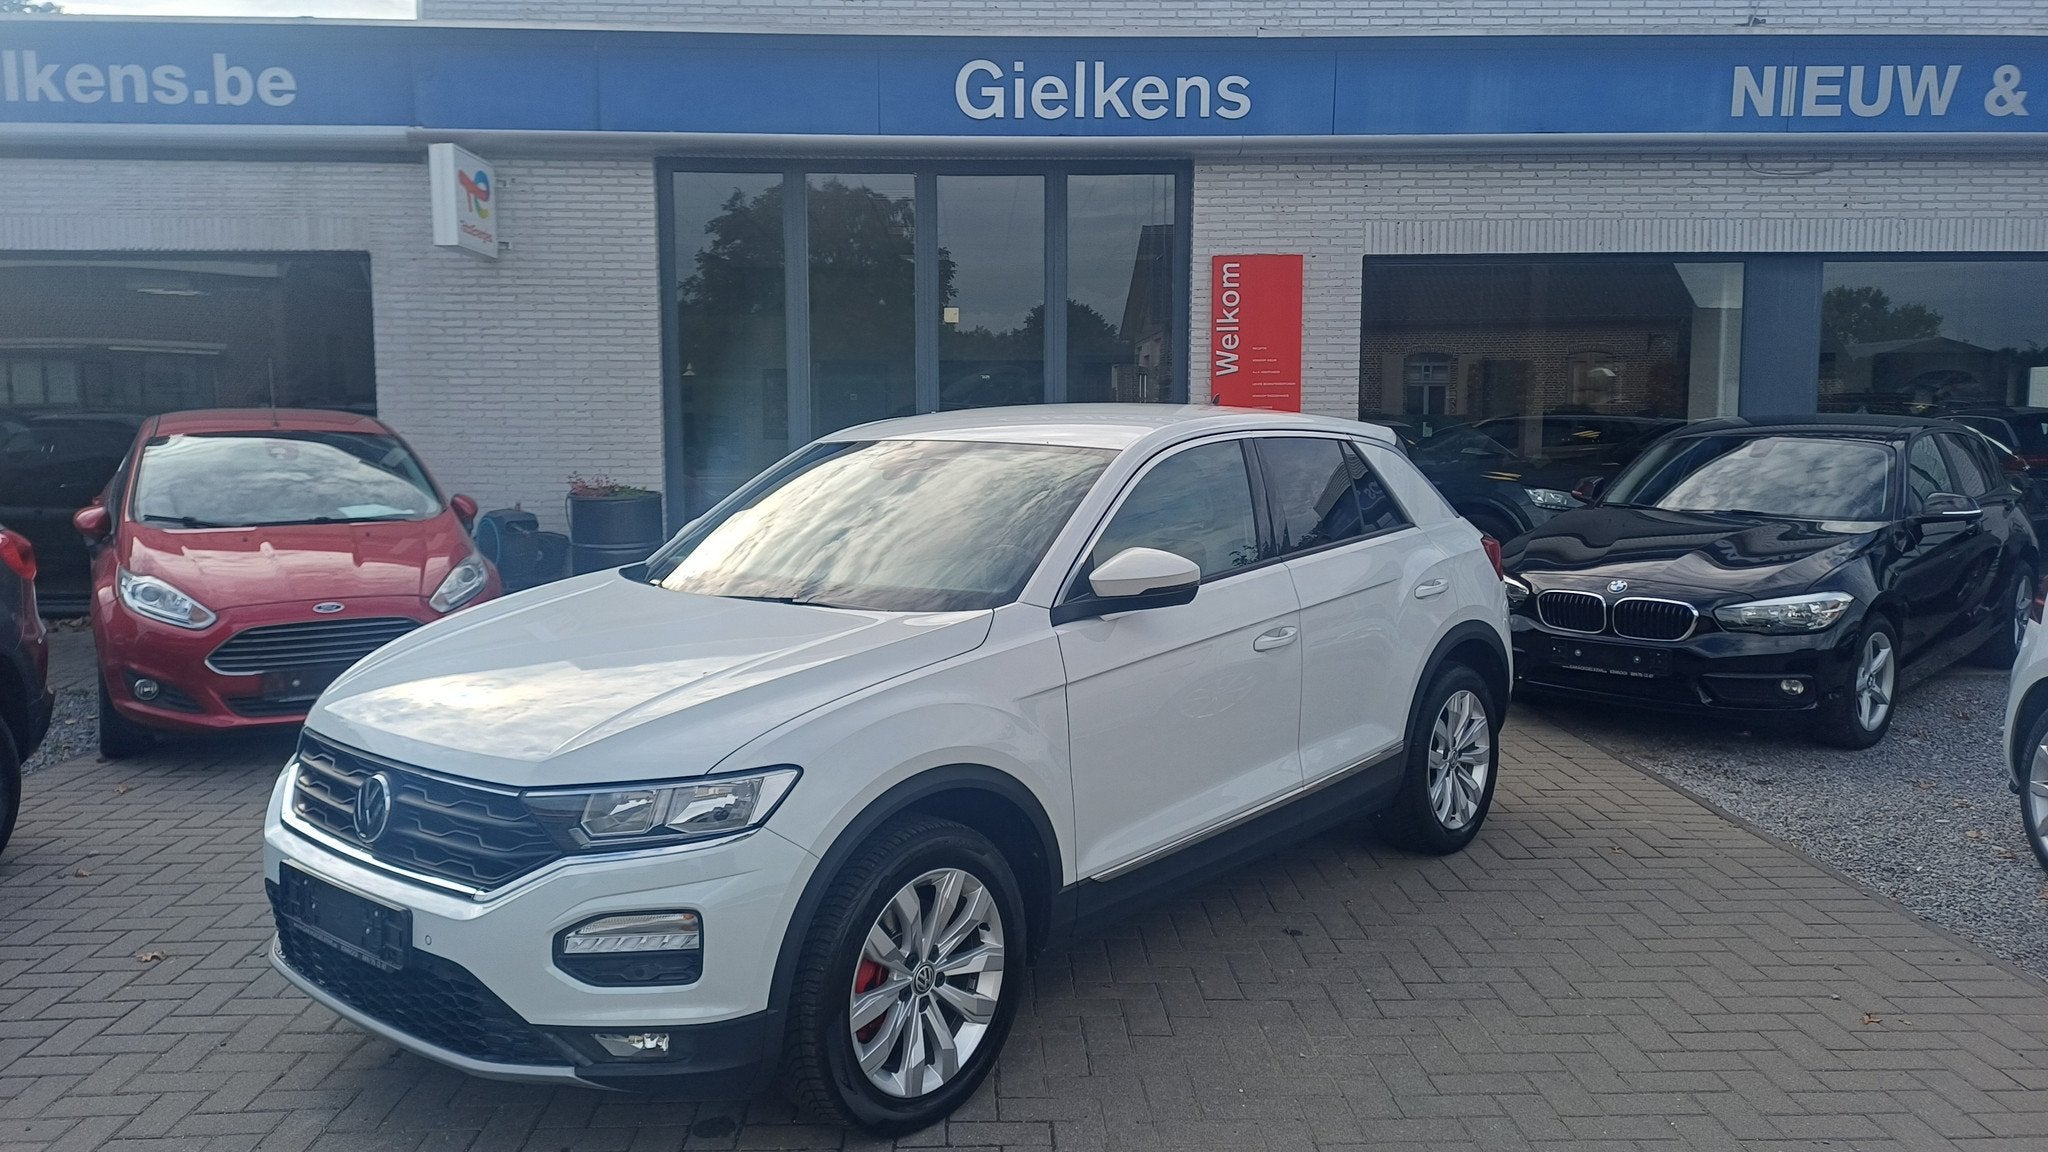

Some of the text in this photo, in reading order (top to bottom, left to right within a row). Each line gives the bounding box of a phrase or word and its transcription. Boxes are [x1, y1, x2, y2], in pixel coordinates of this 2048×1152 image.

[2, 50, 297, 106] lkens.be
[954, 59, 1252, 120] Gielkens
[1731, 64, 2029, 117] NIEUW &
[1215, 262, 1241, 377] Welkom
